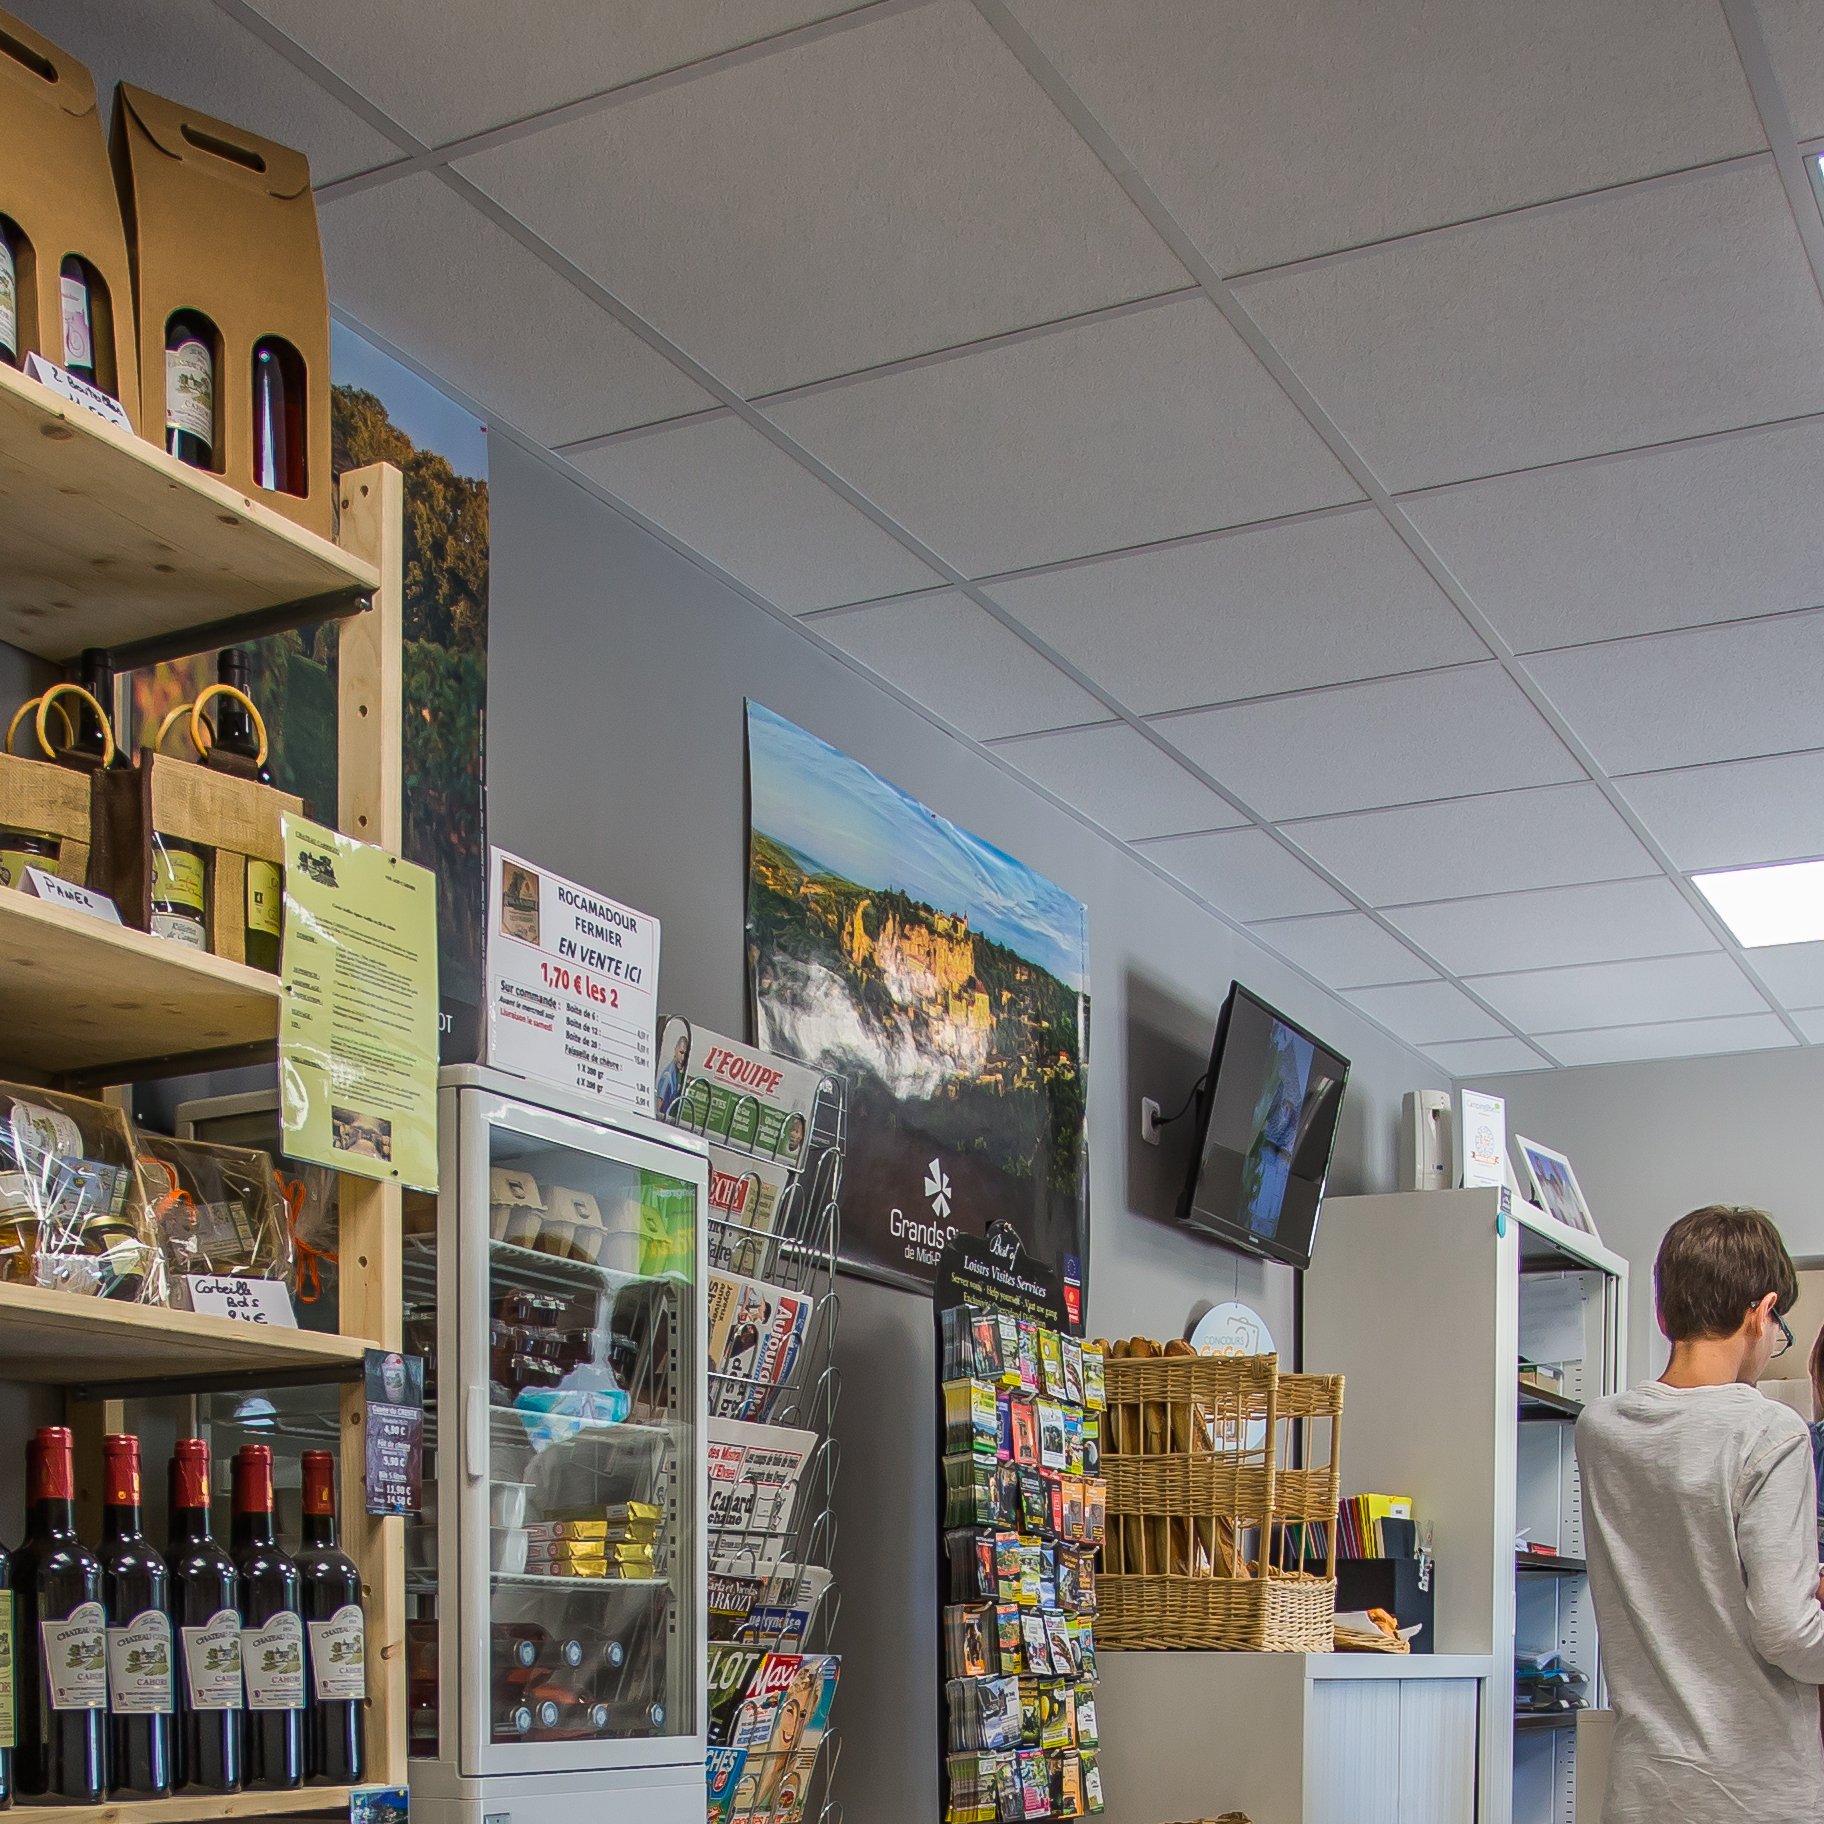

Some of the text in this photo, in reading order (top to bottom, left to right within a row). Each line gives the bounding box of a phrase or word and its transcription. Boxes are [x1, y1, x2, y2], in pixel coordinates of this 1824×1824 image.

[558, 886, 637, 933] ROCAMADOUR
[575, 916, 623, 948] FERMIER
[559, 937, 642, 984] EN VENTE ICI
[500, 979, 556, 1009] Sur commande
[540, 962, 619, 1008] 1,70 € les 2
[500, 1007, 553, 1031] Livraison le samedi
[584, 1006, 591, 1018] de
[583, 1021, 590, 1033] de
[583, 1034, 590, 1047] de
[703, 1046, 784, 1094] L'ÉQUIPE
[890, 1208, 944, 1249] Grands
[904, 1244, 915, 1259] de
[1009, 1243, 1021, 1270] of
[195, 1279, 252, 1296] Corbeille
[964, 1255, 1046, 1298] Loisirs Visites Services
[1204, 1335, 1244, 1346] CONCOURS
[708, 1592, 752, 1611] ARKOZY
[747, 1655, 798, 1697] Maxi
